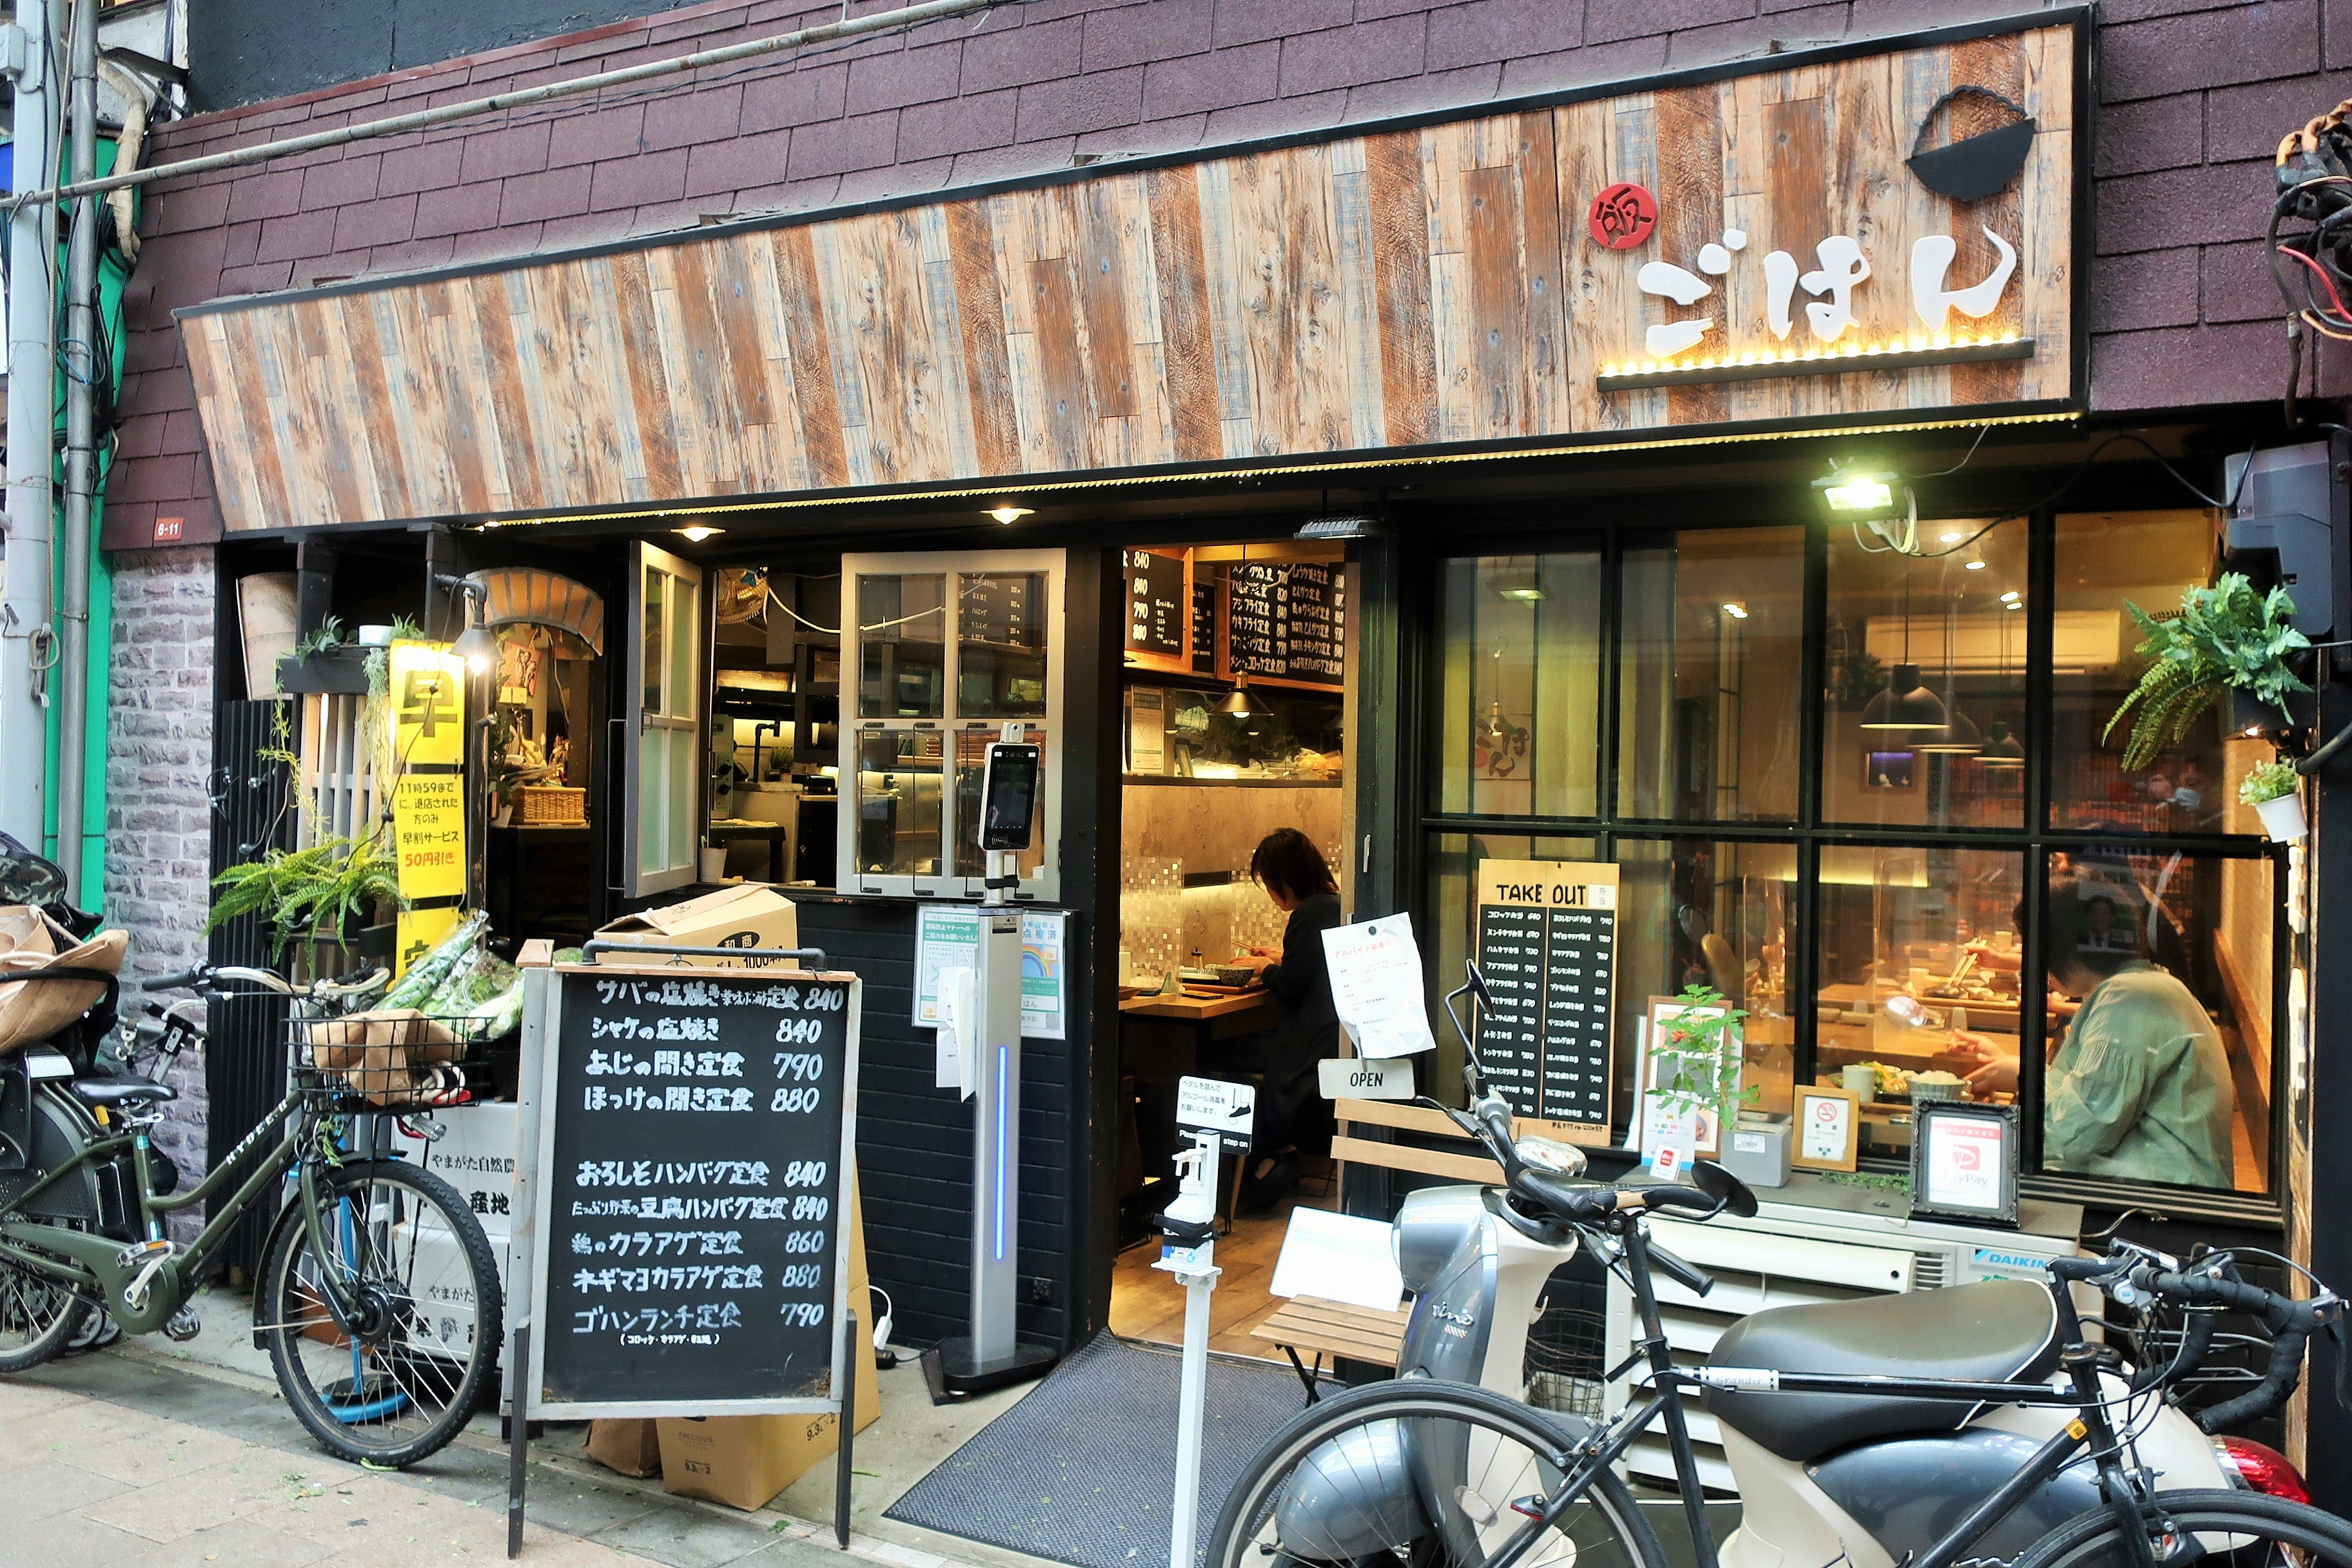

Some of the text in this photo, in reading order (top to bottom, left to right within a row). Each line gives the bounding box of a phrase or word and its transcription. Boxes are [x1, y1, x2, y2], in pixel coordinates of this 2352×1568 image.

[1637, 224, 2017, 358] ごはん
[158, 522, 179, 536] 6-11
[1133, 551, 1150, 569] 840
[1133, 601, 1149, 620] 790
[400, 670, 457, 738] 早
[400, 783, 454, 794] 11時59まで
[399, 798, 458, 810] に、退店された
[413, 814, 439, 825] 方のみ
[403, 830, 459, 845] 早割サービス
[405, 852, 455, 867] 50円引き
[1496, 884, 1586, 905] TAKE OUT
[803, 988, 844, 1011] 840
[591, 1016, 823, 1044] シャケの塩焼き 840
[585, 1048, 824, 1082] あじの開き定食 790
[1182, 1080, 1221, 1092] ペダルを踏んで
[1350, 1072, 1384, 1087] OPEN
[583, 1086, 820, 1114] ほっけの開き定食 880
[1181, 1092, 1226, 1104] アルコール消毒を
[1181, 1103, 1217, 1115] お願いします。
[1179, 1130, 1197, 1139] Pleas
[1223, 1138, 1239, 1147] step
[783, 1161, 827, 1188] 840
[467, 1190, 510, 1216] 産地
[791, 1195, 829, 1222] 840
[571, 1230, 825, 1257] 鶏のカラアゲ定食 860
[573, 1264, 821, 1294] ネギマヨカラアゲ定食 880
[572, 1301, 825, 1334] ゴハンランチ定食 790
